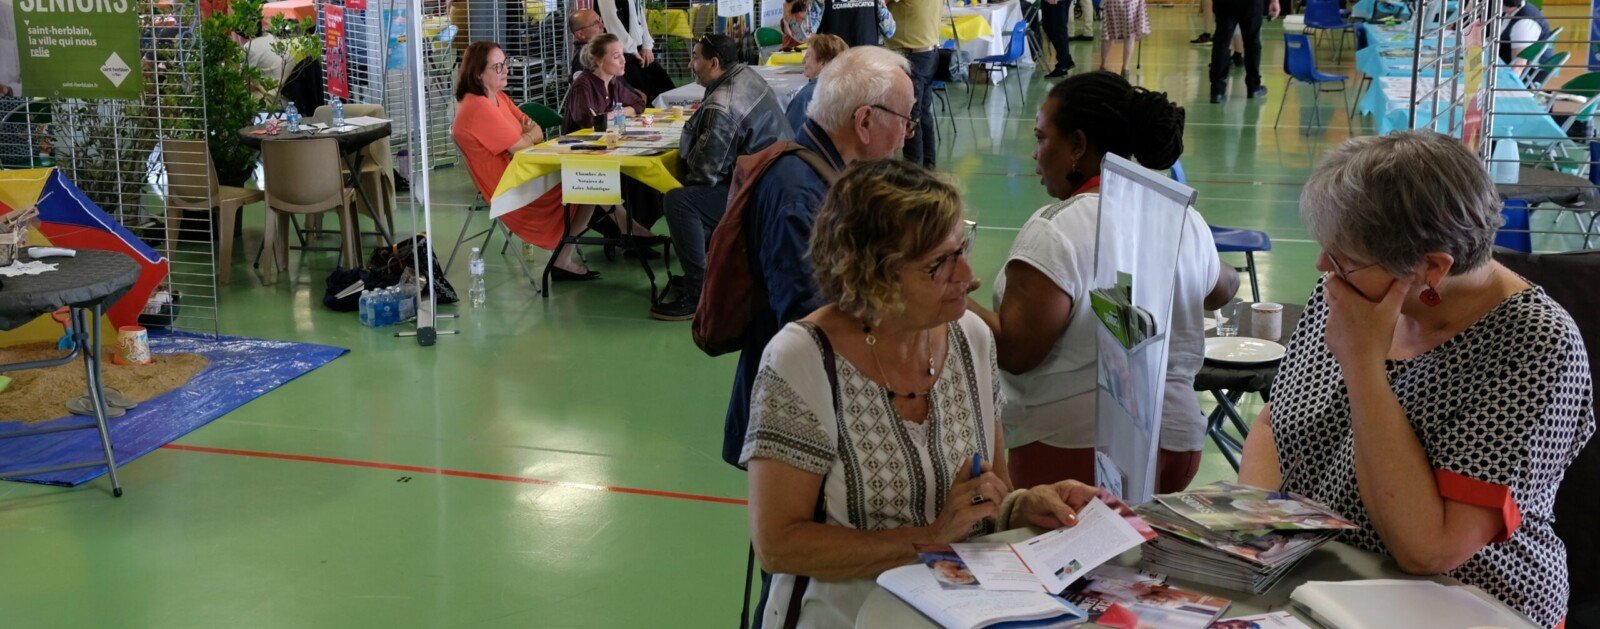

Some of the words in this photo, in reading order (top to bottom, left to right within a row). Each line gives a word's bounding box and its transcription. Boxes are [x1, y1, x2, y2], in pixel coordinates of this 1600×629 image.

[27, 26, 92, 36] saint-herblain,
[29, 36, 37, 46] la
[39, 37, 57, 46] ville
[58, 38, 74, 48] qui
[75, 38, 97, 47] nous
[30, 46, 50, 57] relie
